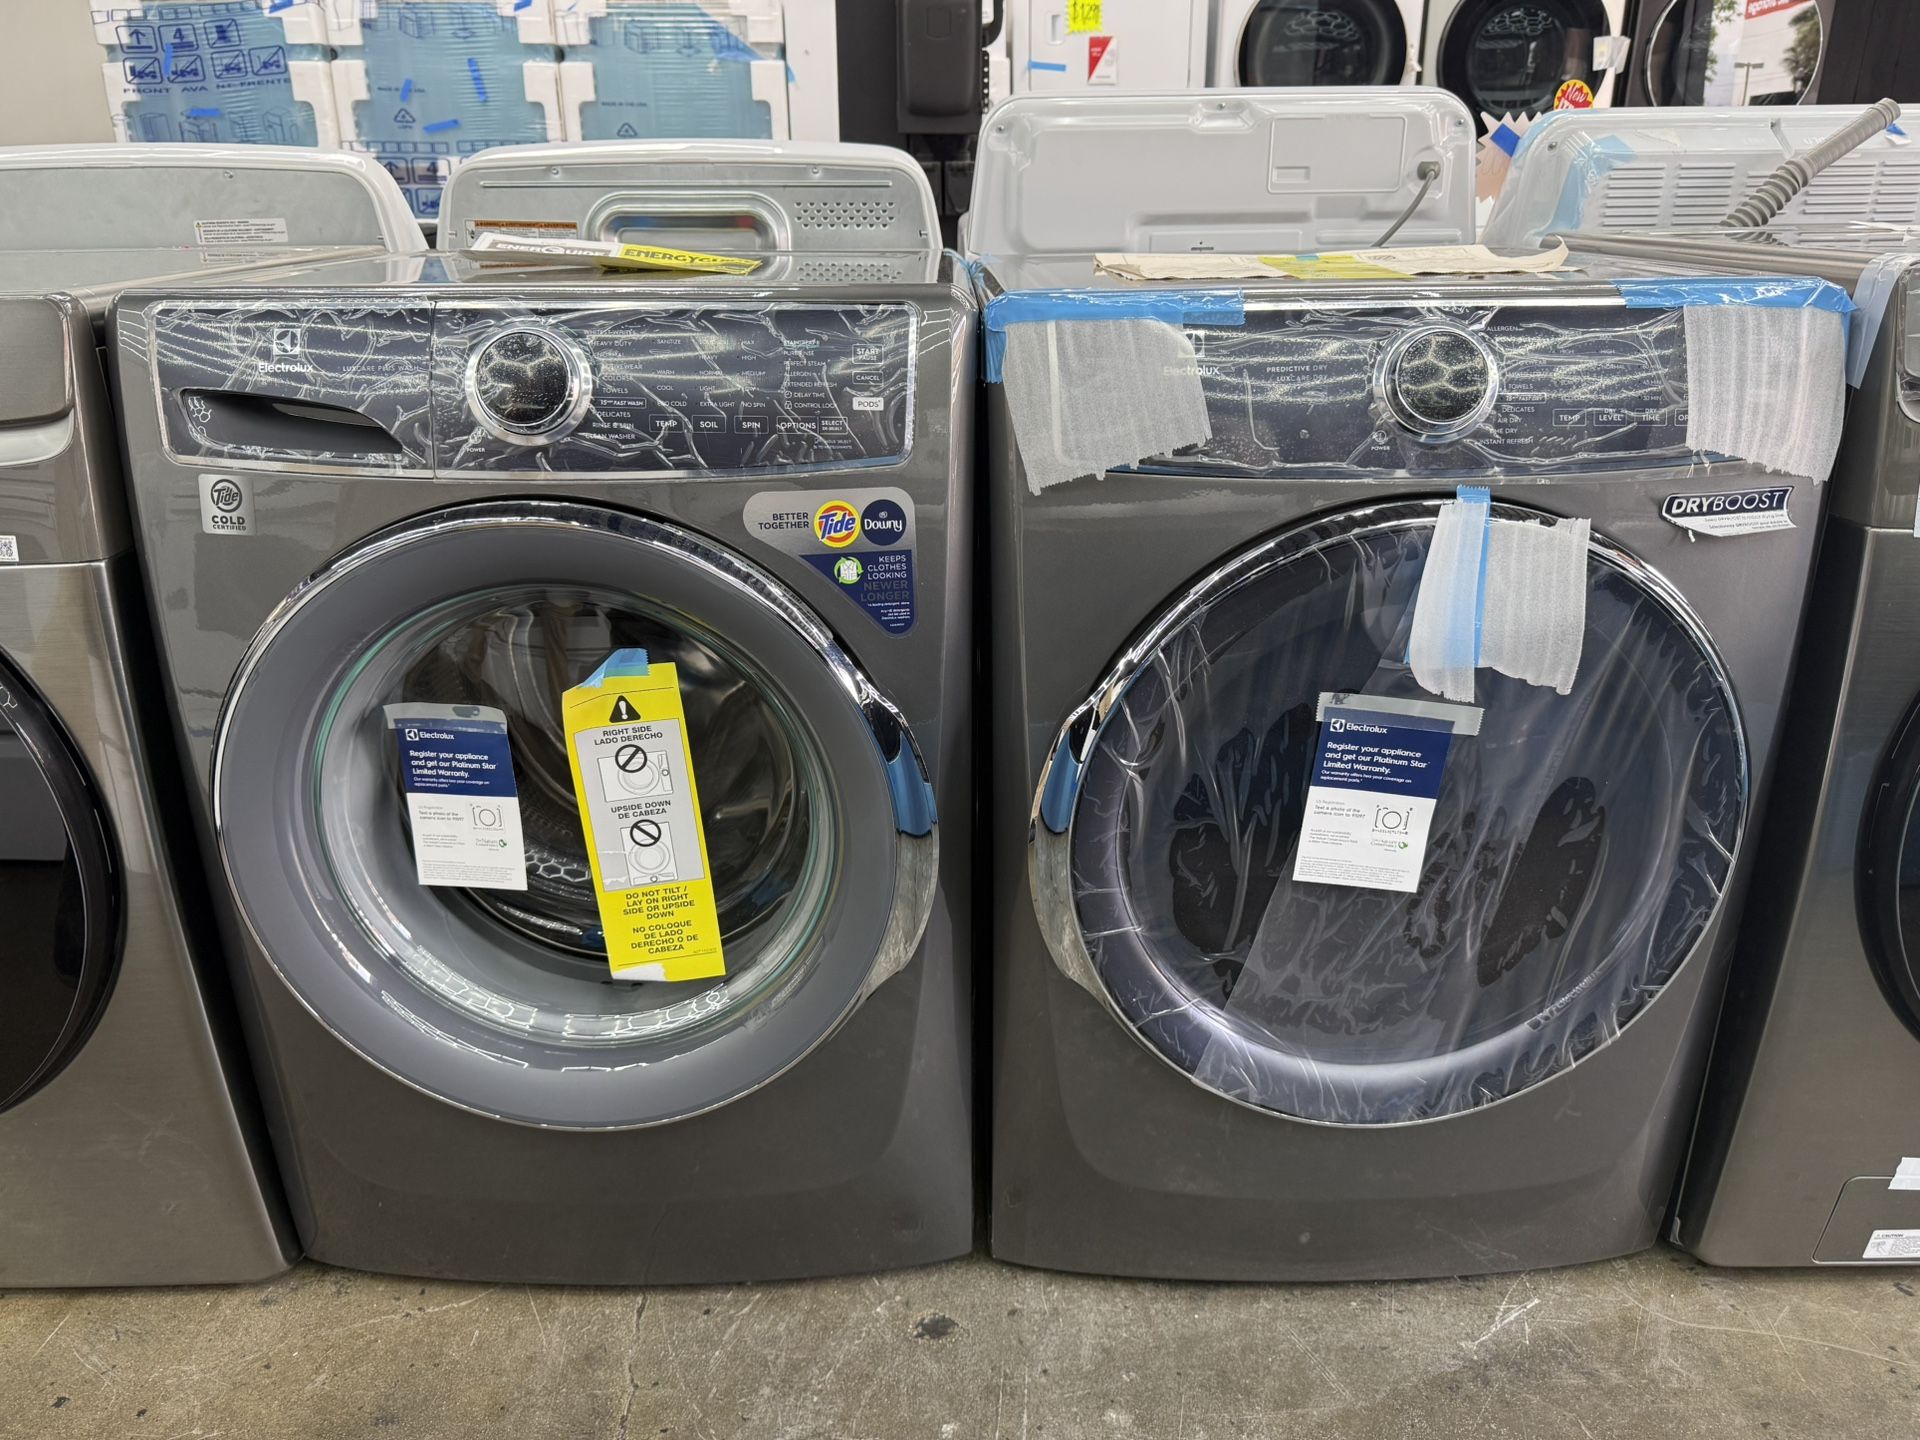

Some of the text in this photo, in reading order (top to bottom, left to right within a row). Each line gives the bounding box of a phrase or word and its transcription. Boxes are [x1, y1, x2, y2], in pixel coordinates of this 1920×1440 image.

[1564, 84, 1588, 102] New
[258, 363, 314, 373] Electrolux
[1164, 366, 1222, 376] Electrolux
[213, 486, 239, 506] Tide
[1671, 492, 1783, 514] DRYBOOST
[211, 515, 245, 525] COLD
[772, 512, 809, 520] BETTER
[758, 521, 809, 530] TOGETHER
[818, 512, 857, 541] Tide
[864, 518, 903, 532] Downy
[879, 555, 907, 563] KEEPS
[867, 563, 907, 572] CLOTHES
[867, 572, 907, 580] LOOKING
[864, 580, 908, 591] NEWER
[860, 592, 909, 602] LONGER
[602, 726, 652, 737] RIGHT SIDE
[1346, 723, 1388, 734] Electrolux
[420, 732, 455, 740] Electrolux
[594, 732, 663, 746] LADO DERECHO
[409, 750, 437, 758] Register
[1327, 742, 1359, 751] Register
[1381, 747, 1422, 757] appliance
[451, 761, 480, 769] Platinum
[1323, 761, 1391, 774] Limited Warranty.
[1373, 756, 1408, 766] Platinum
[1410, 760, 1428, 768] Star
[438, 769, 470, 778] Warranty.
[611, 800, 671, 813] UPSIDE DOWN
[618, 808, 667, 820] DE CABEZA
[626, 892, 639, 900] DO
[642, 889, 660, 897] NOT
[663, 886, 681, 895] TILT
[661, 893, 689, 902] RIGHT
[623, 906, 644, 915] SIDE
[662, 900, 695, 910] UPSIDE
[646, 911, 674, 920] DOWN
[648, 920, 692, 931] COLOQUE
[660, 929, 683, 938] LADO
[631, 937, 674, 949] DERECHO
[648, 944, 684, 954] CABEZA
